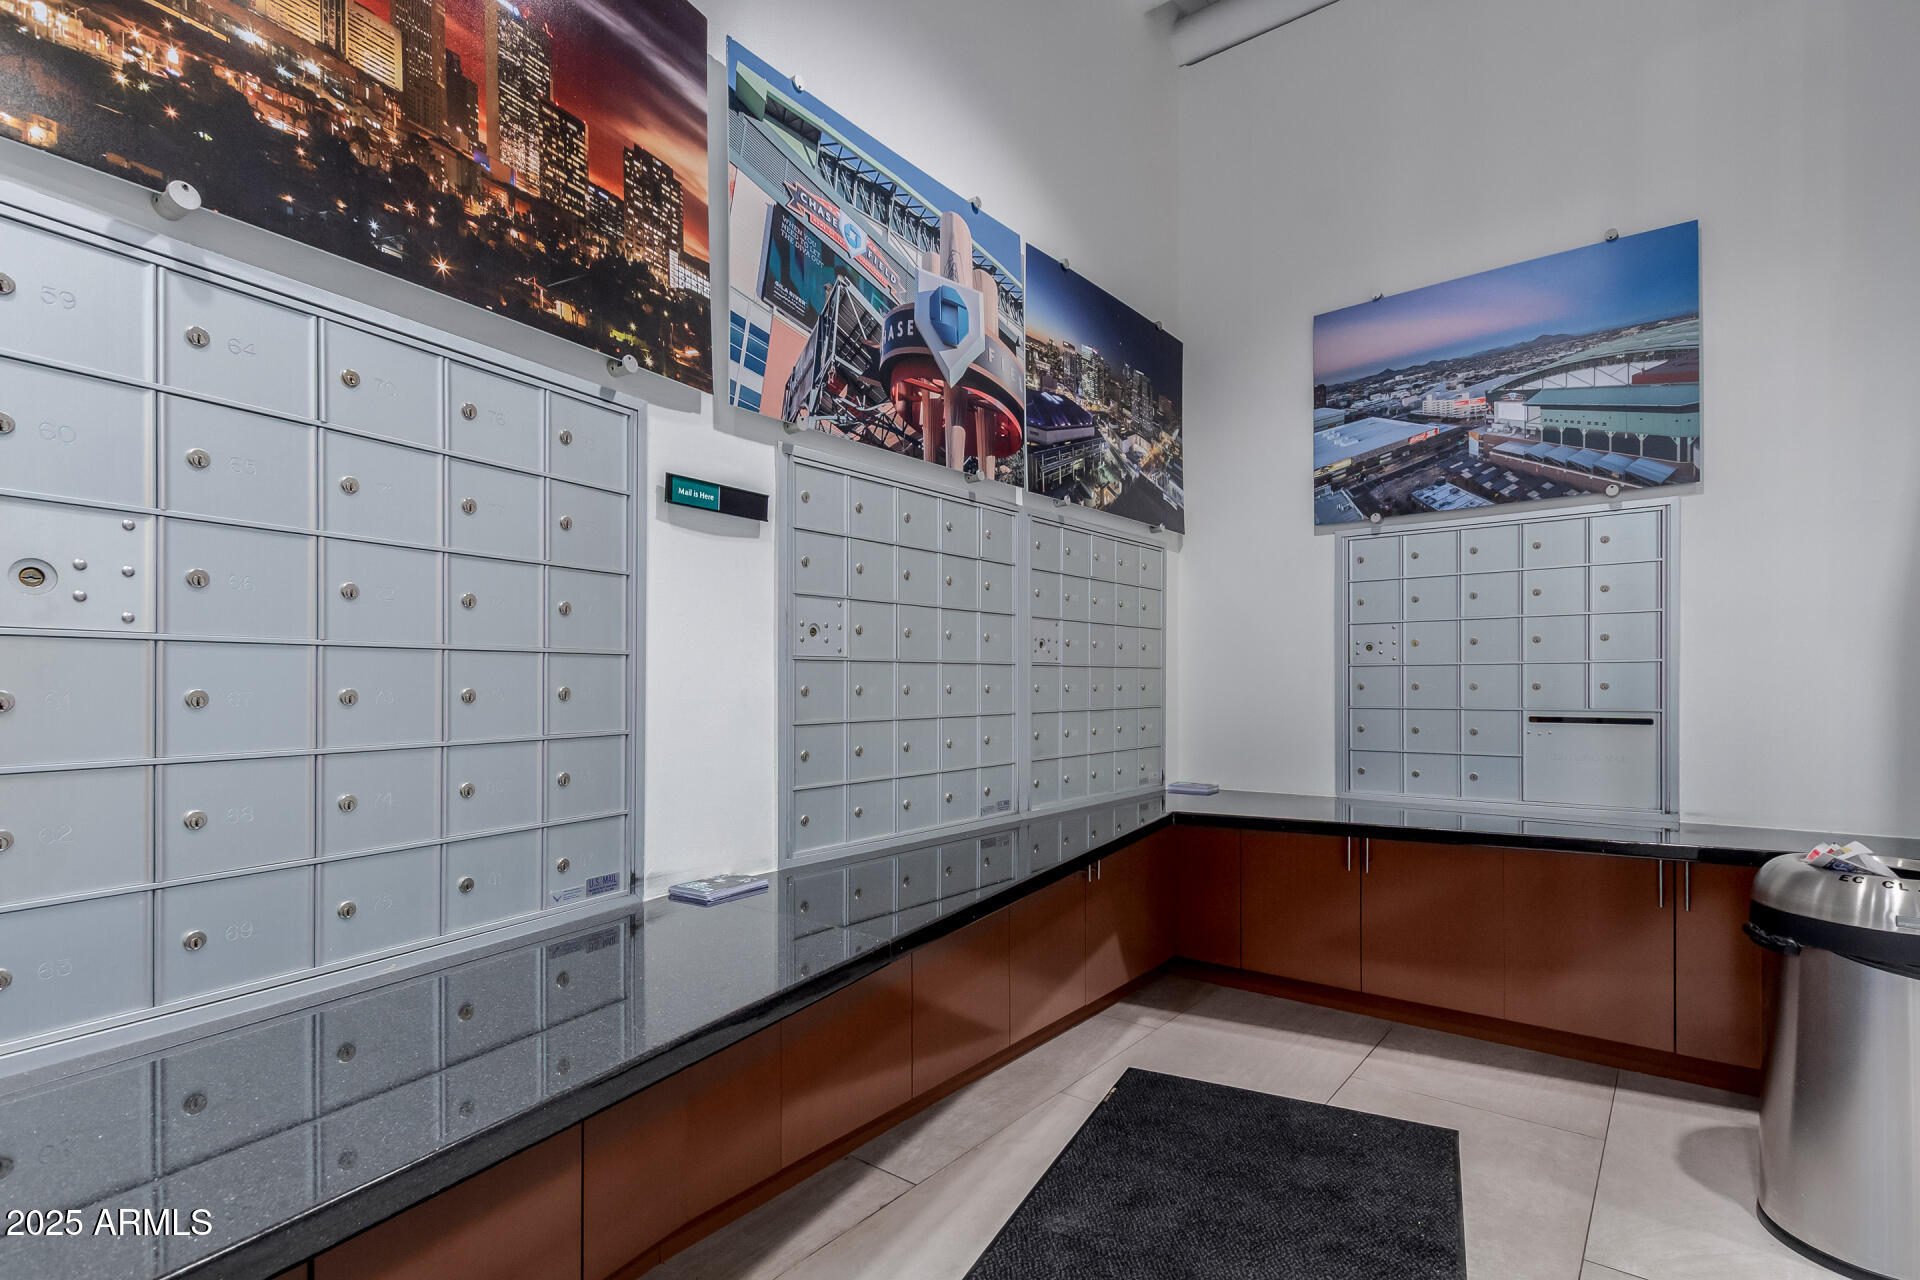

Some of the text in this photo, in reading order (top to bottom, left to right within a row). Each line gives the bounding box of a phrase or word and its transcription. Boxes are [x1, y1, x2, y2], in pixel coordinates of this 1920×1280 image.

[782, 214, 803, 236] WHEN
[800, 192, 838, 229] CHASE
[867, 250, 897, 284] FIELD
[41, 285, 76, 309] 59
[227, 338, 257, 357] 64
[987, 346, 1024, 393] FIEL
[39, 421, 77, 444] 60
[678, 487, 715, 501] Mail is Here
[602, 872, 617, 884] MAIL
